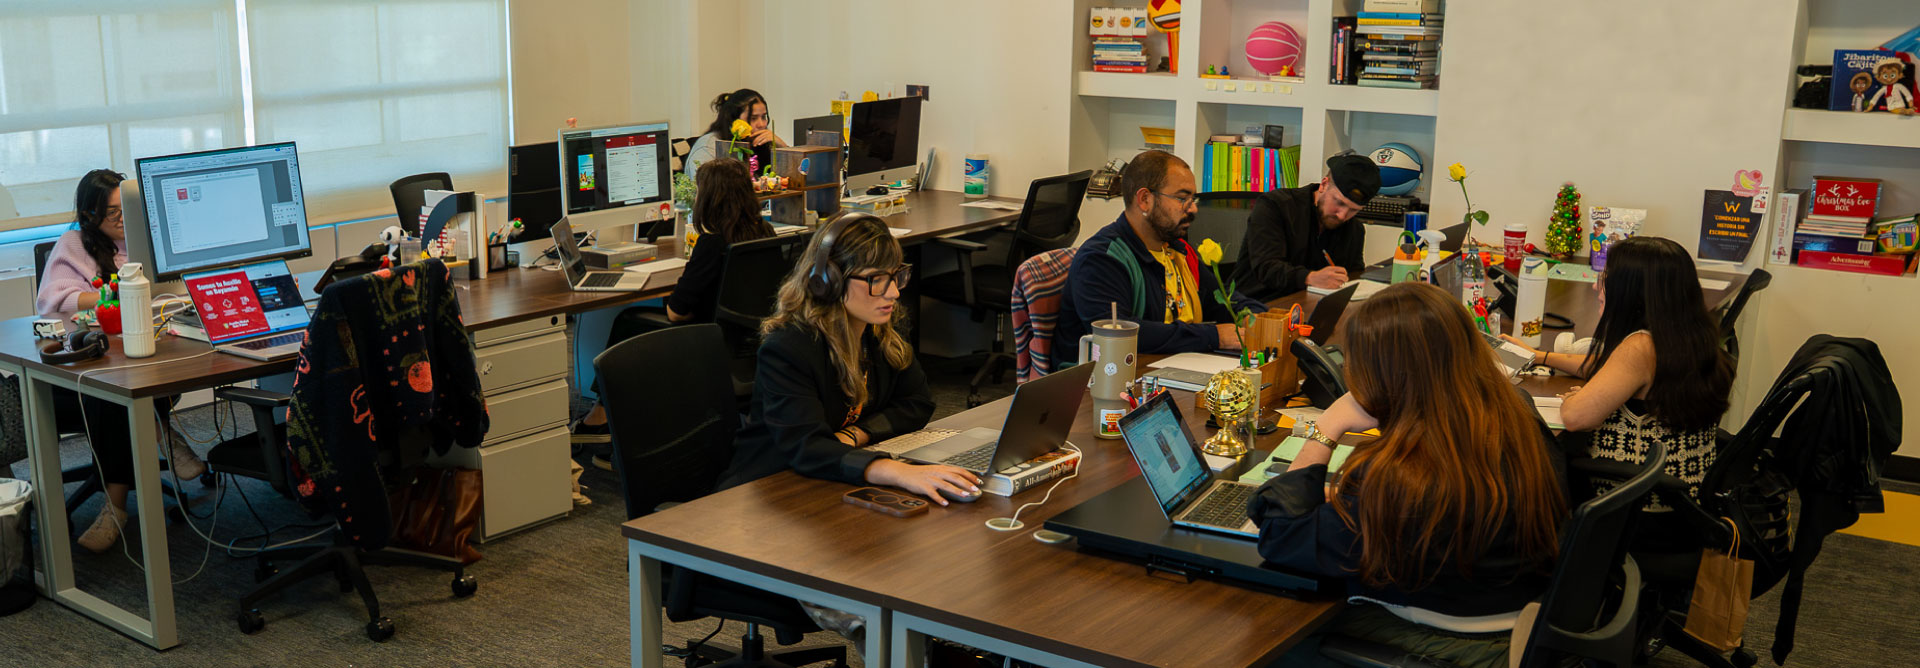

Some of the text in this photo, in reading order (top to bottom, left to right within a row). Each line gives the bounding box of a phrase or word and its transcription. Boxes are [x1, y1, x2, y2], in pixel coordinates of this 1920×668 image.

[1843, 53, 1887, 62] Jibarito
[1847, 61, 1875, 69] Cajit
[1816, 193, 1871, 206] Christmas Eve
